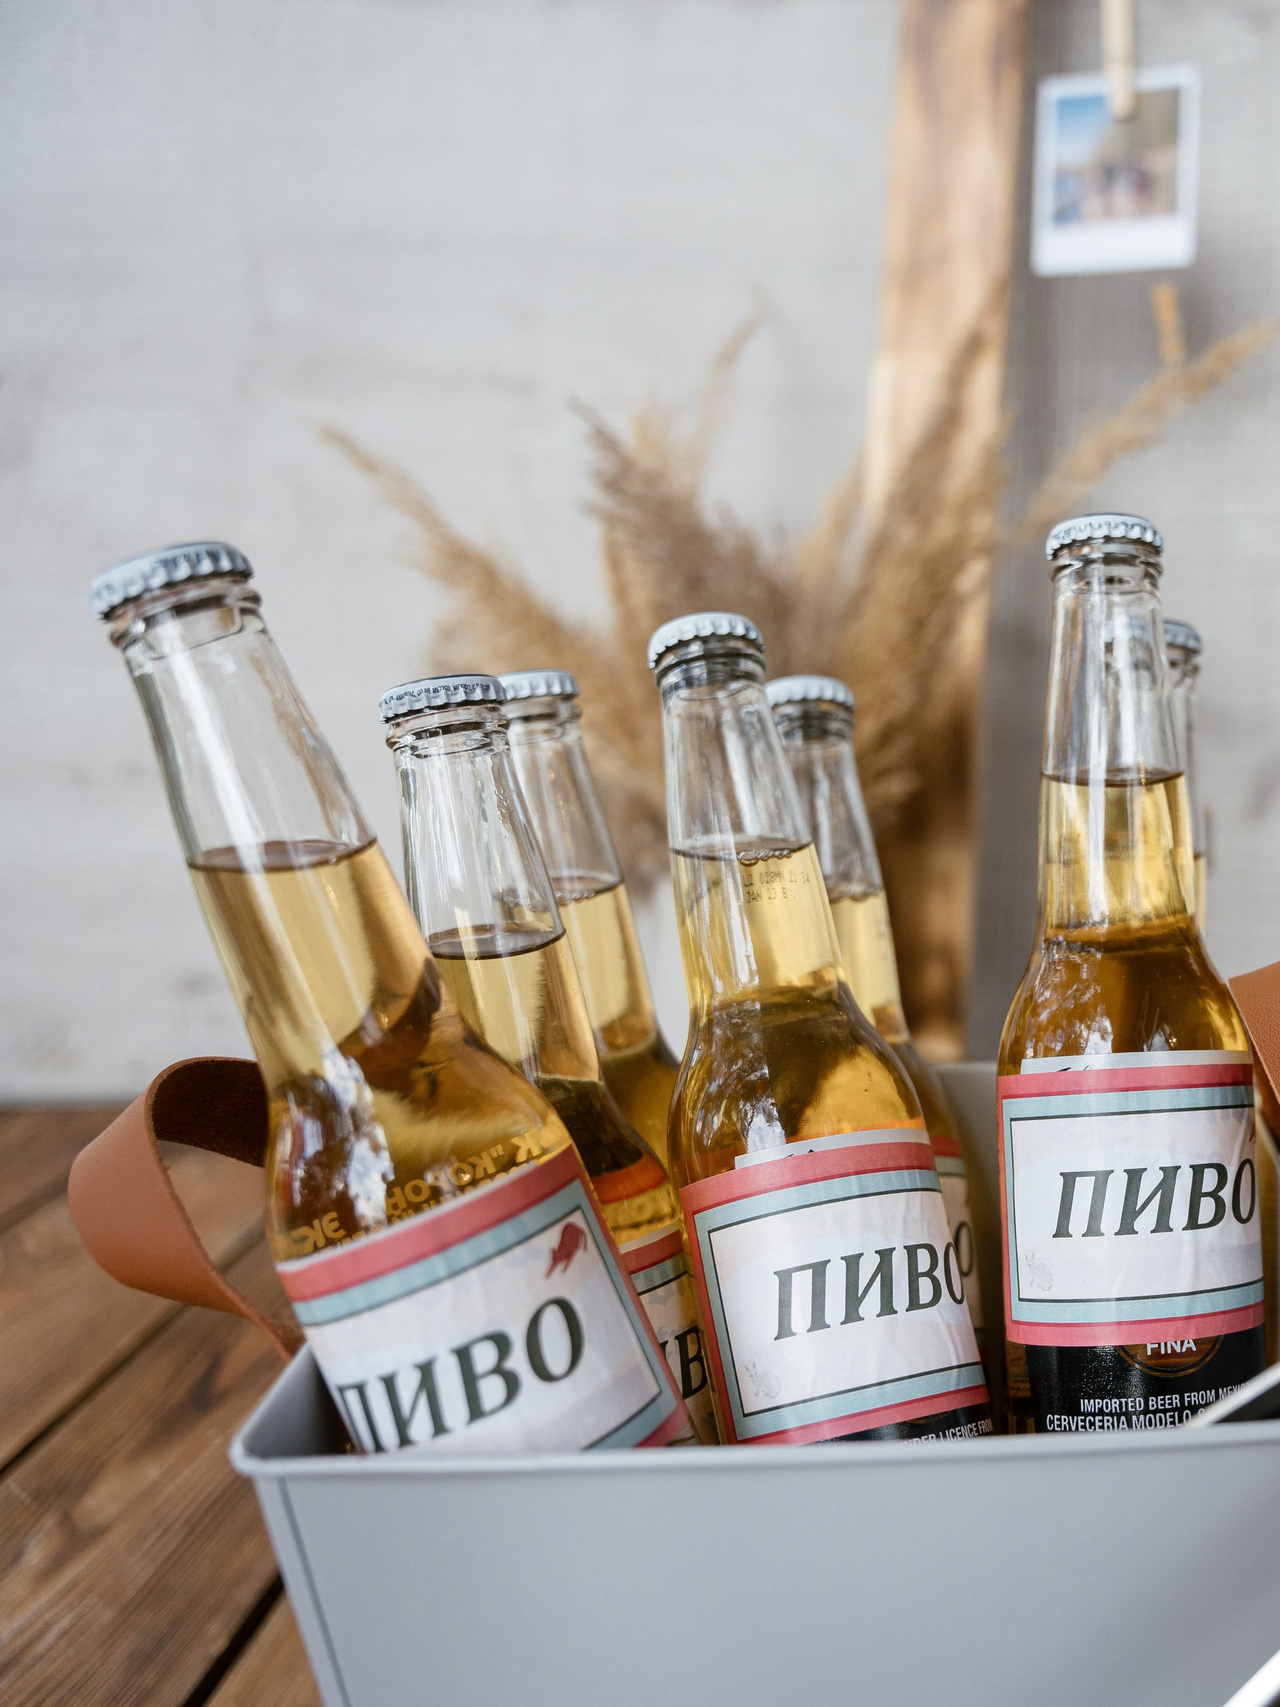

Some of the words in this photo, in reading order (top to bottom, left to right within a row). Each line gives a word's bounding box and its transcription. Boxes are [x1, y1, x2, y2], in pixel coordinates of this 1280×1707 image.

[1052, 1158, 1256, 1238] ПИВО
[773, 1242, 965, 1341] ПИВО
[1146, 1339, 1197, 1356] FINA
[337, 1297, 584, 1452] ПИВО
[1080, 1397, 1144, 1414] IMPORTED
[1148, 1394, 1180, 1410] BEER
[1184, 1389, 1216, 1407] FROM
[939, 1422, 979, 1442] LICENCE
[1132, 1409, 1191, 1431] MODELO
